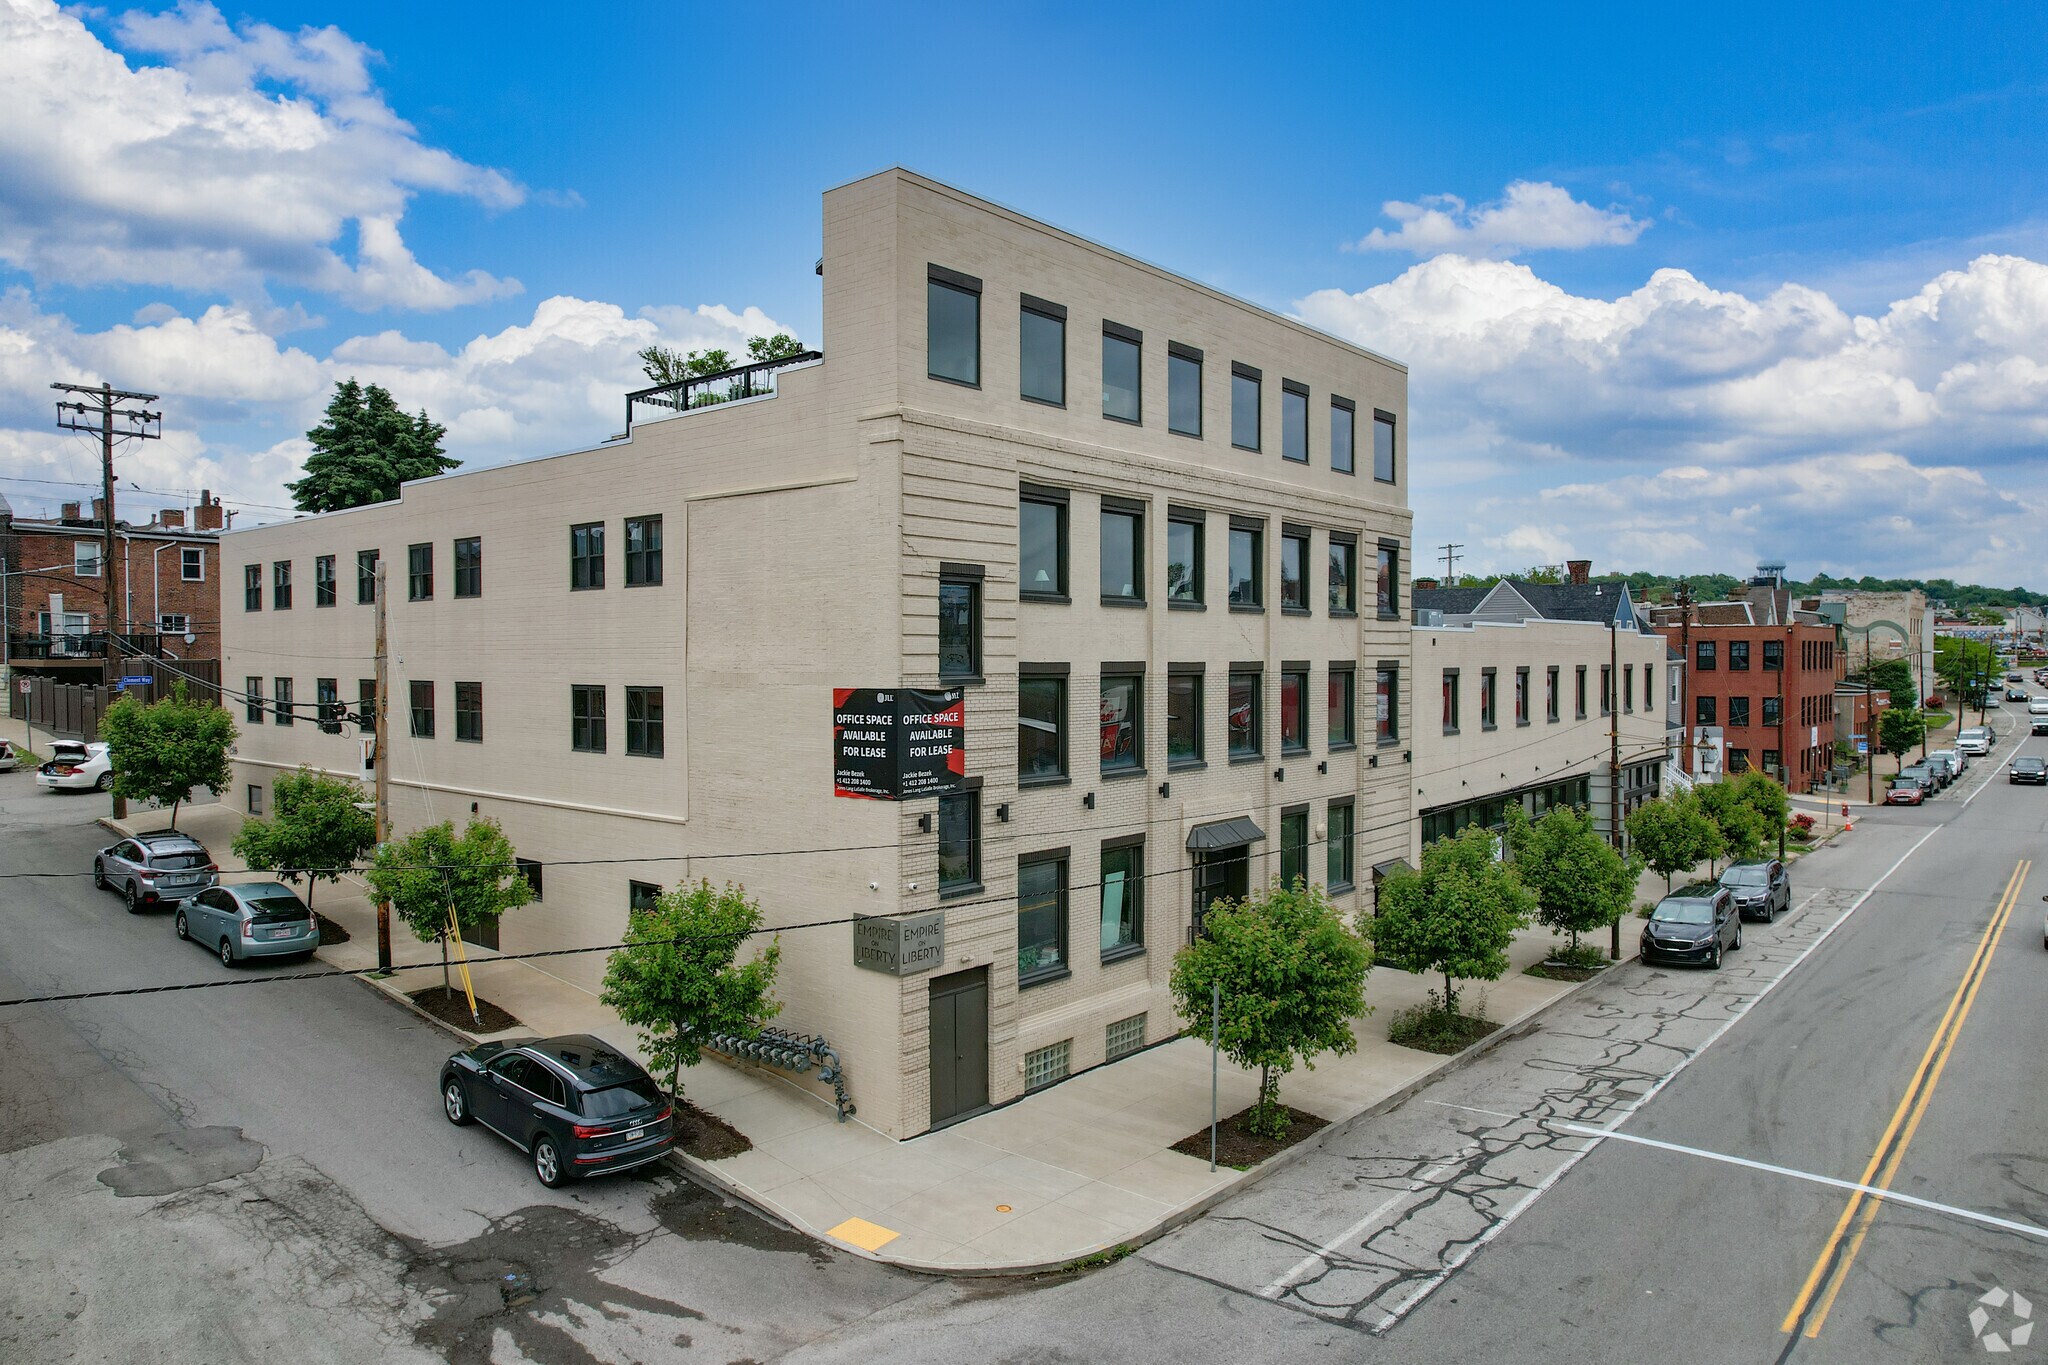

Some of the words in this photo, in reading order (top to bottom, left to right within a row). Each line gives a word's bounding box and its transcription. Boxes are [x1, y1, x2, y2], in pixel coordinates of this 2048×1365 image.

[836, 714, 864, 724] OFFICE
[866, 715, 893, 725] SPACE
[903, 714, 932, 725] OFFICE
[934, 712, 958, 723] SPACE
[843, 731, 886, 741] AVAILABLE
[910, 729, 952, 741] AVAILABLE
[843, 746, 859, 757] FOR
[861, 748, 886, 758] LEASE
[910, 746, 926, 758] FOR
[928, 745, 953, 756] LEASE
[857, 924, 893, 941] EMPIRE
[904, 923, 940, 941] EMPIRE
[856, 946, 896, 964] LIBERTY
[903, 945, 941, 964] LIBERTY
